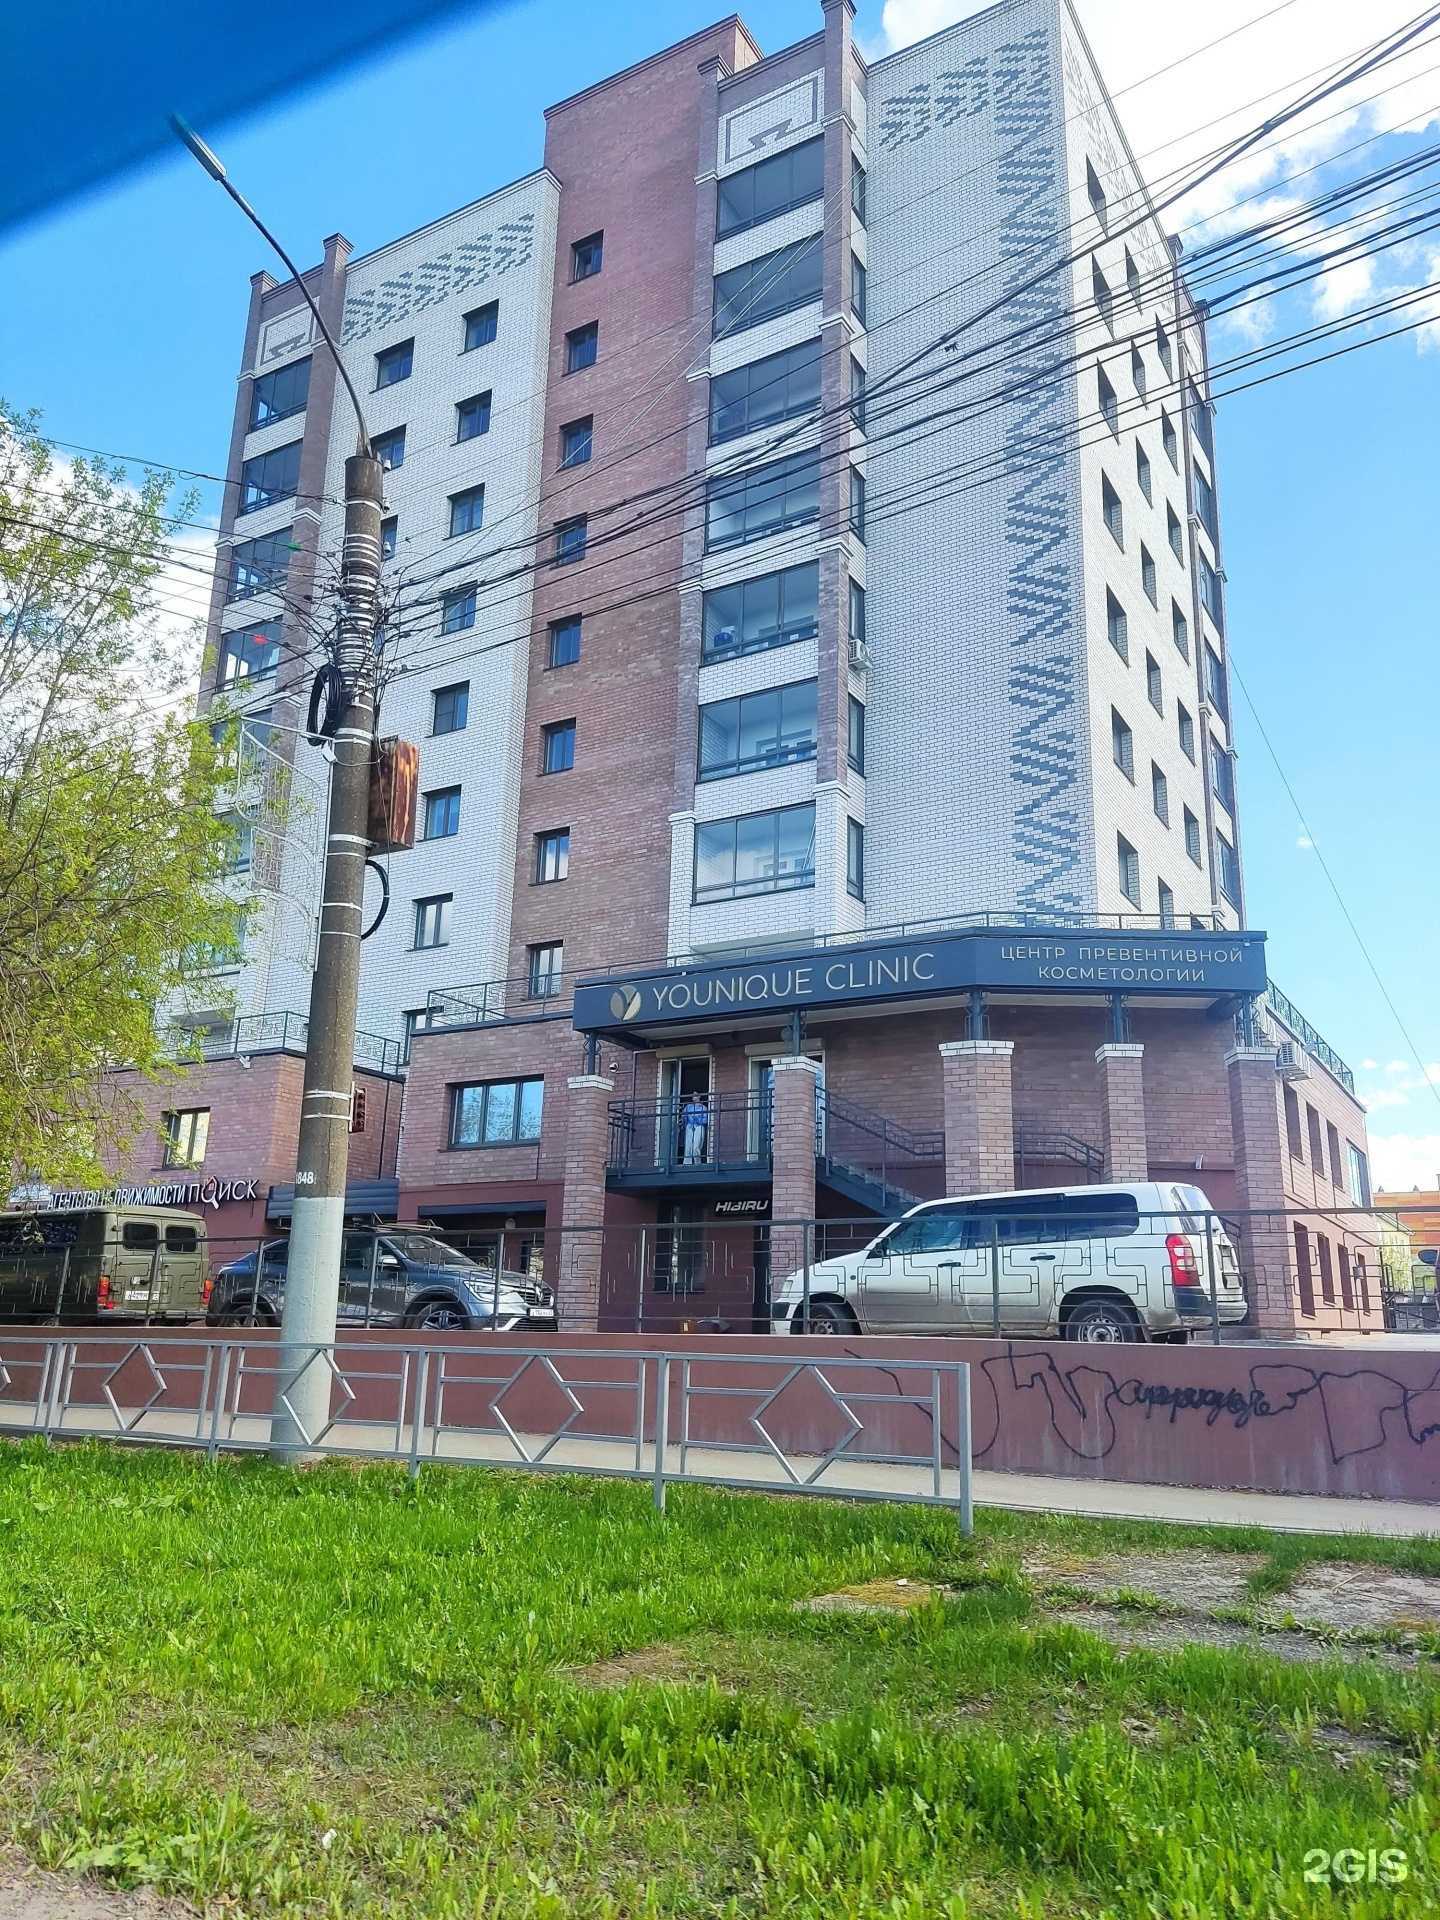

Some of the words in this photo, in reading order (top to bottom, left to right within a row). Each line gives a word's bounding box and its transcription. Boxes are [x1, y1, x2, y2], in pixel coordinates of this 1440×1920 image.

[1001, 946, 1066, 961] ЦЕНТР
[1079, 947, 1243, 963] ПРЕВЕНТИВНОЙ
[652, 967, 813, 1011] YOUNIQUE
[825, 953, 935, 990] CLINIC
[1038, 966, 1205, 982] КОСМЕТОЛОГИИ
[188, 1175, 258, 1209] ПОИСК
